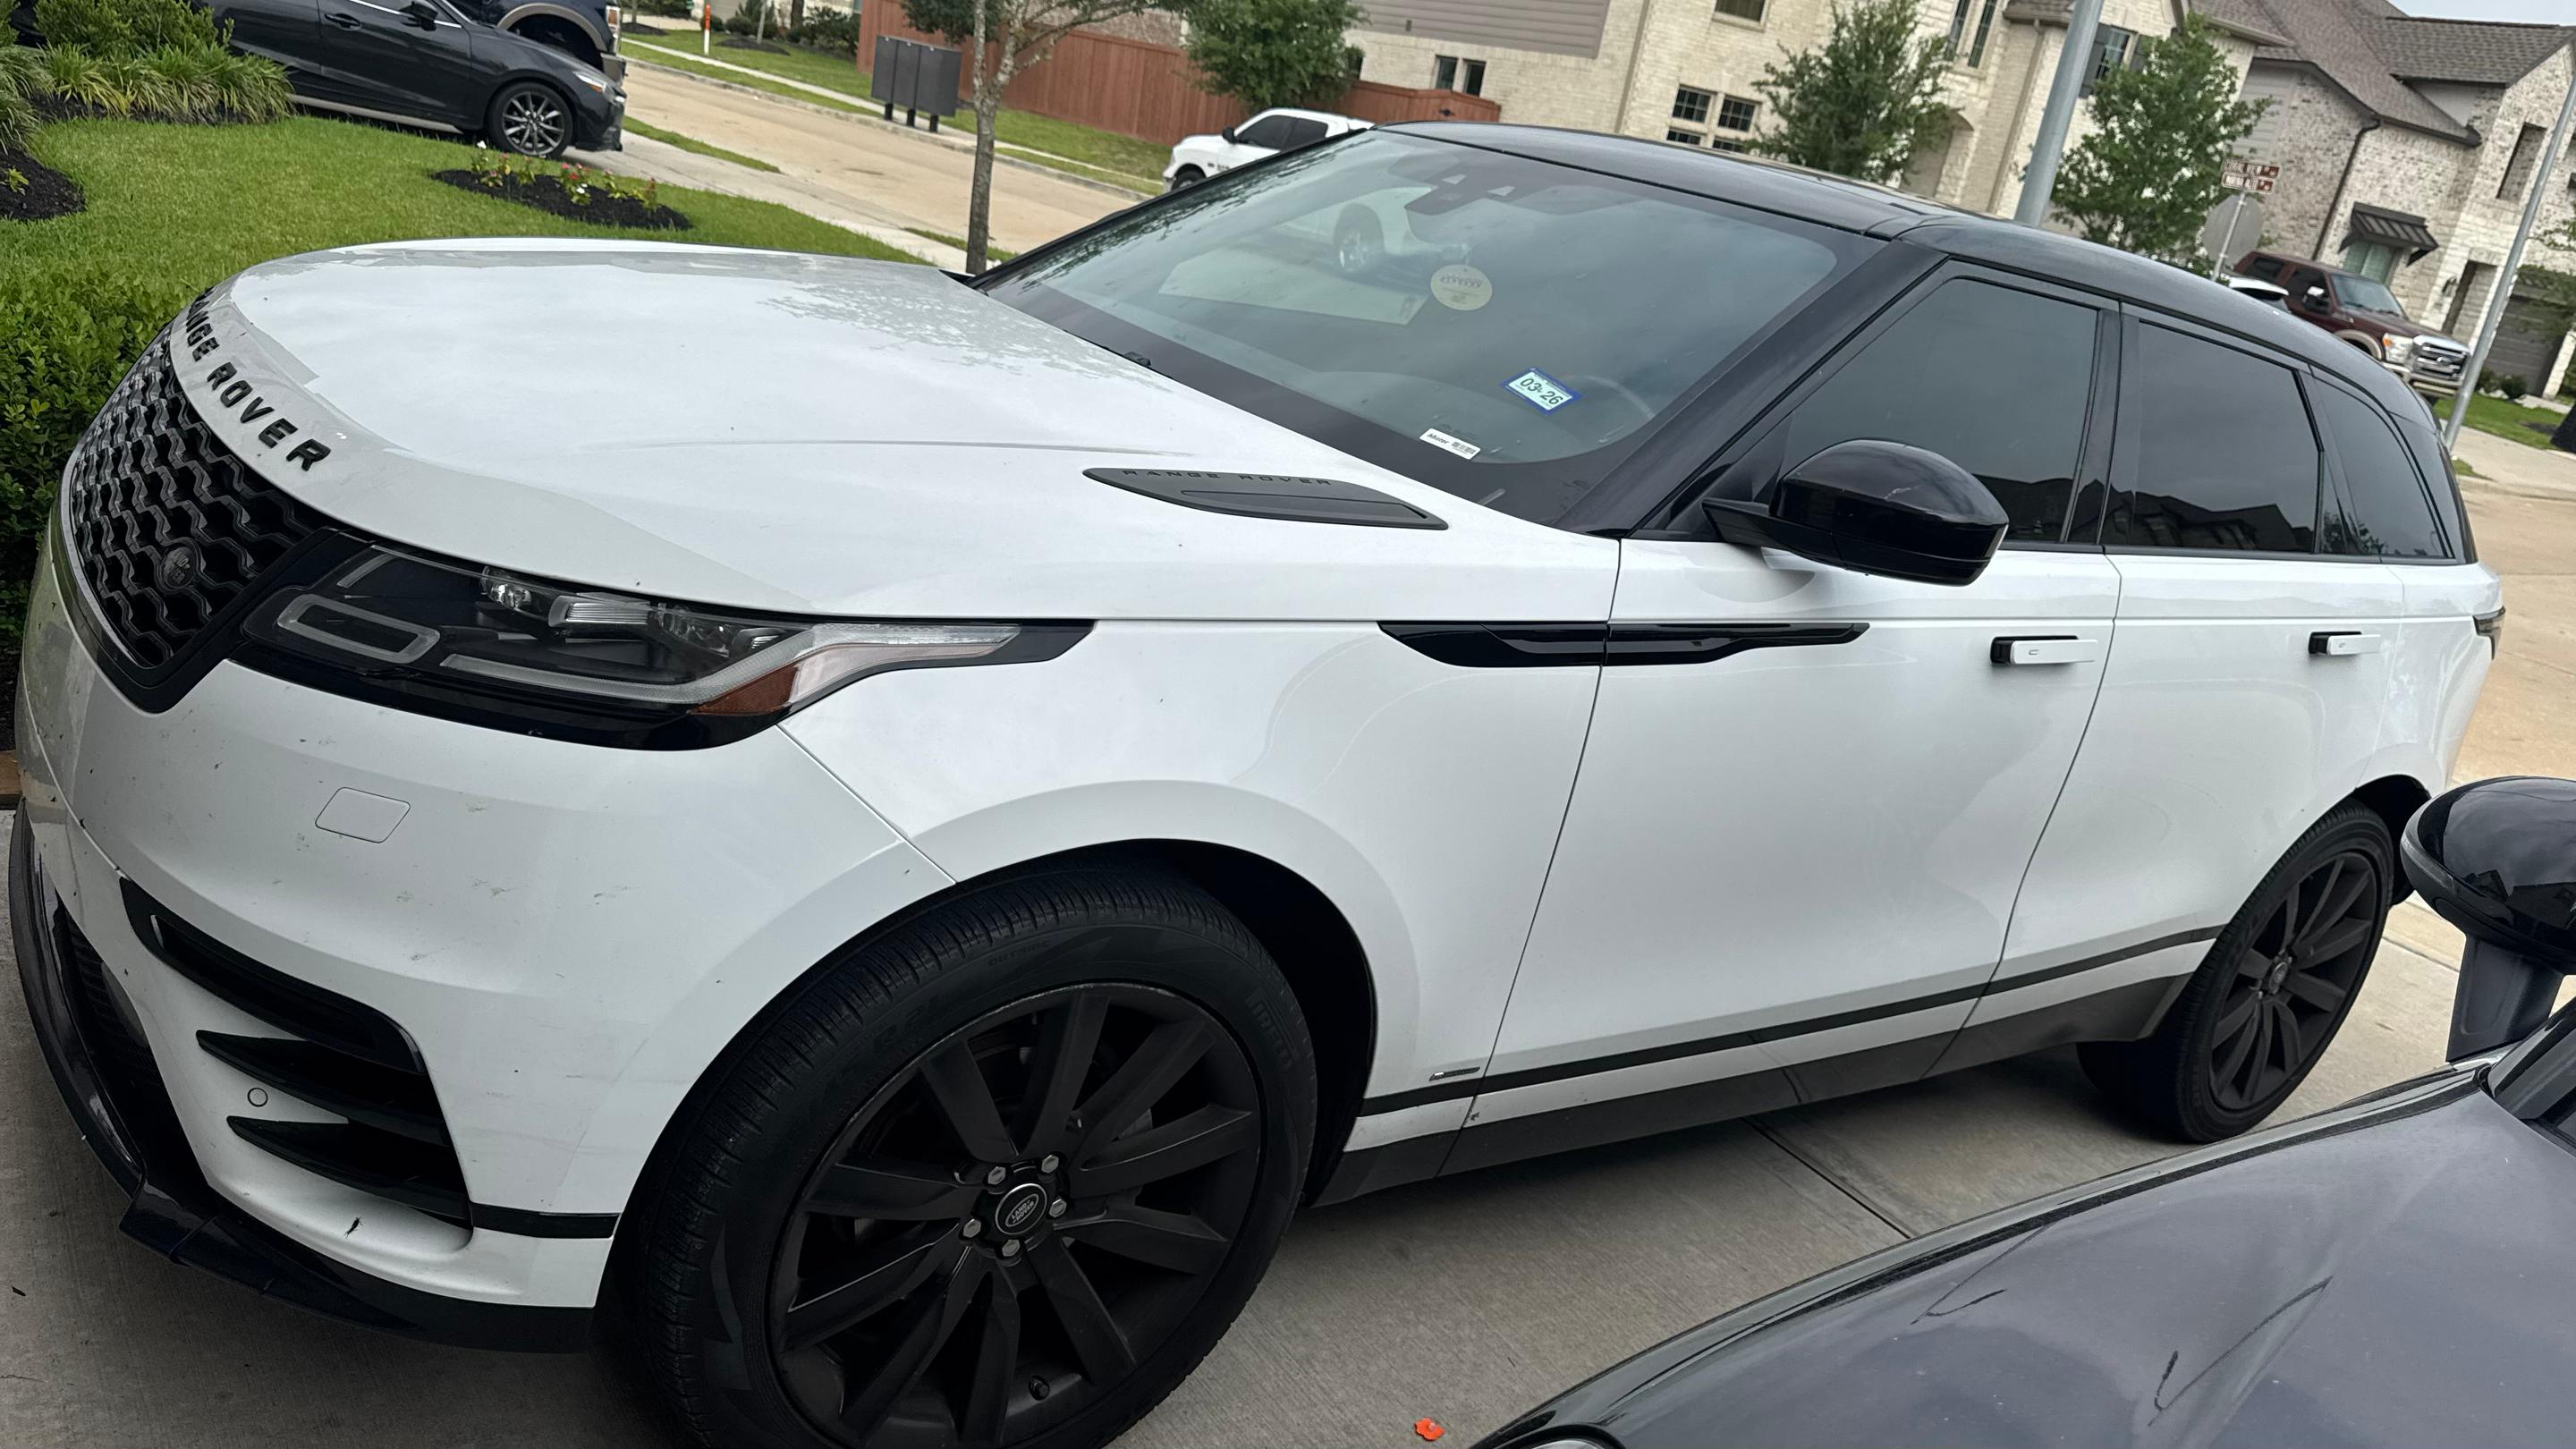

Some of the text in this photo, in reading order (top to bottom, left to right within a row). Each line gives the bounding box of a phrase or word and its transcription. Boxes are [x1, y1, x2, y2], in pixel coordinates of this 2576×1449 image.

[207, 361, 331, 471] ROVER
[1122, 470, 1332, 486] RANGE ROVER
